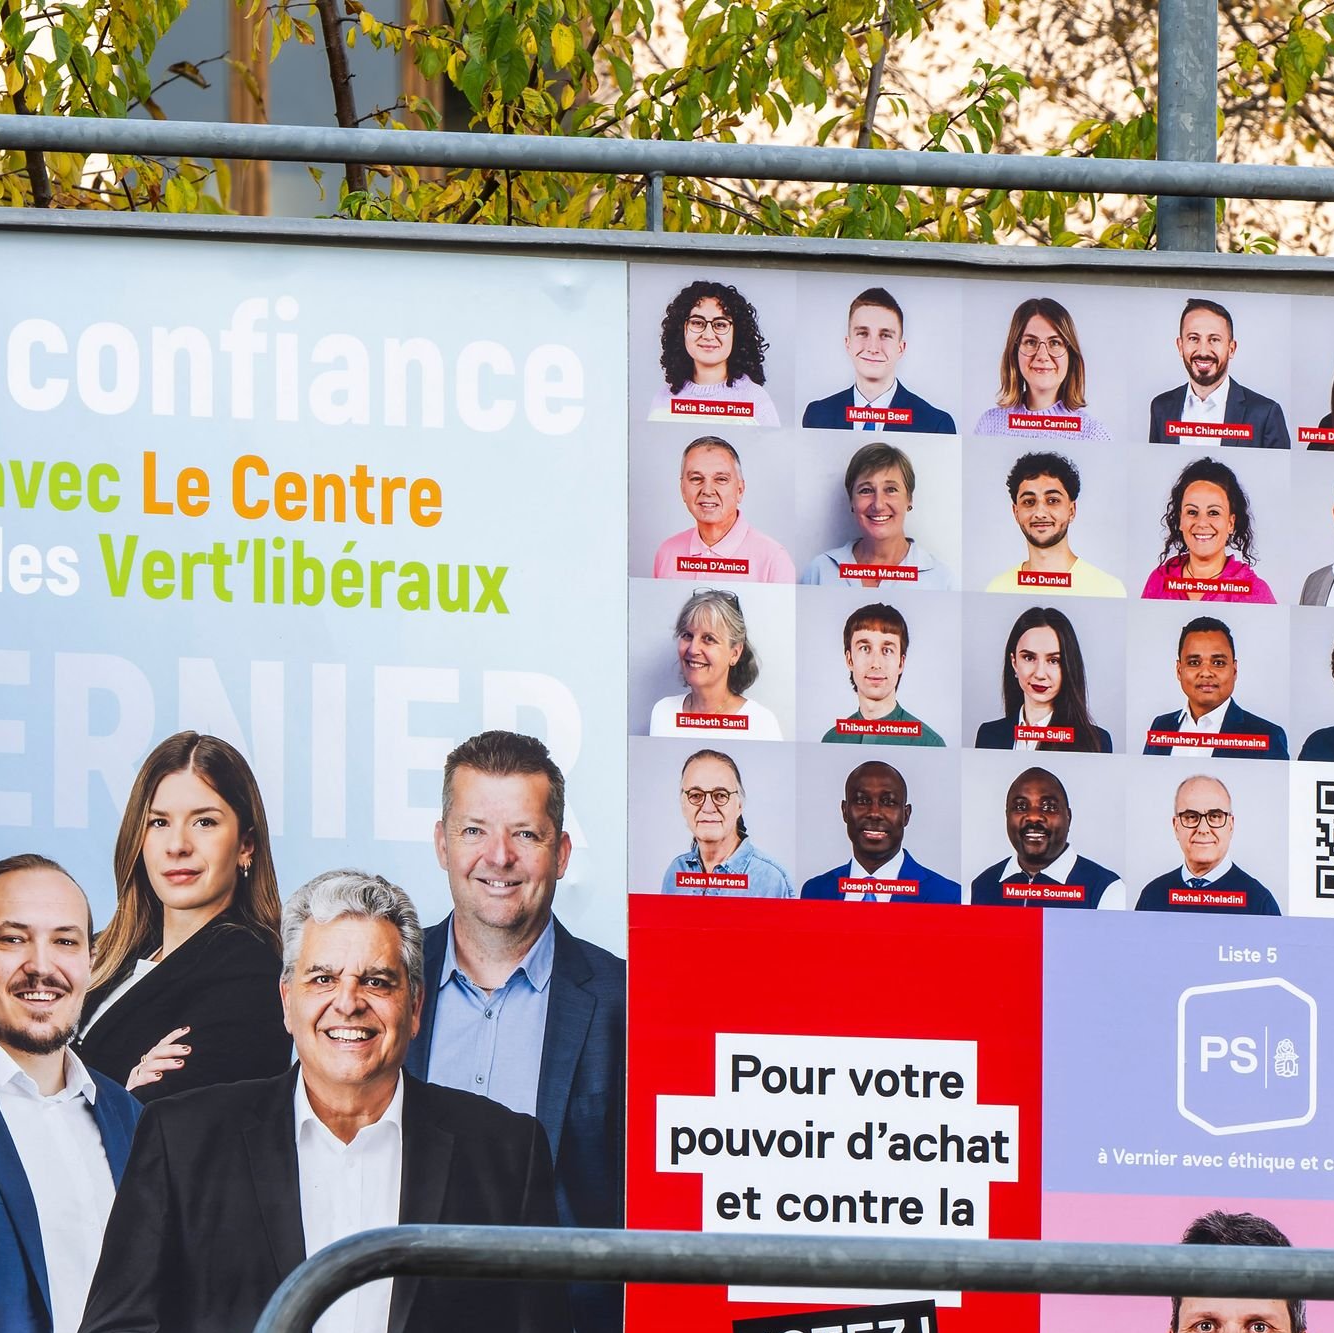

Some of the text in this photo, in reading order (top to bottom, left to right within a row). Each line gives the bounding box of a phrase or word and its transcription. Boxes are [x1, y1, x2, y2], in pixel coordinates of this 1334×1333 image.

[6, 295, 584, 437] confiance
[674, 403, 751, 416] Katia Bento Pinto
[848, 409, 909, 422] Mathieu Beer
[142, 451, 210, 518] Le
[231, 455, 442, 528] Centre
[99, 533, 509, 614] Vert'libéraux
[680, 560, 746, 572] Nicola D'Amico
[1020, 574, 1068, 585] Léo Dunkel
[1168, 580, 1249, 592] Marie-Rose Milano
[679, 717, 746, 728] Elisabeth Santi
[1219, 946, 1277, 964] Liste 5
[1201, 1035, 1258, 1074] PS
[732, 1054, 964, 1099] Pour votre
[671, 1120, 1009, 1164] pouvoir d'achat
[1098, 1149, 1108, 1164] à
[1113, 1148, 1177, 1166] Vernier
[1182, 1154, 1223, 1168] avec
[1228, 1151, 1295, 1173] éthique
[1300, 1156, 1318, 1170] et
[716, 1187, 974, 1226] et contre la
